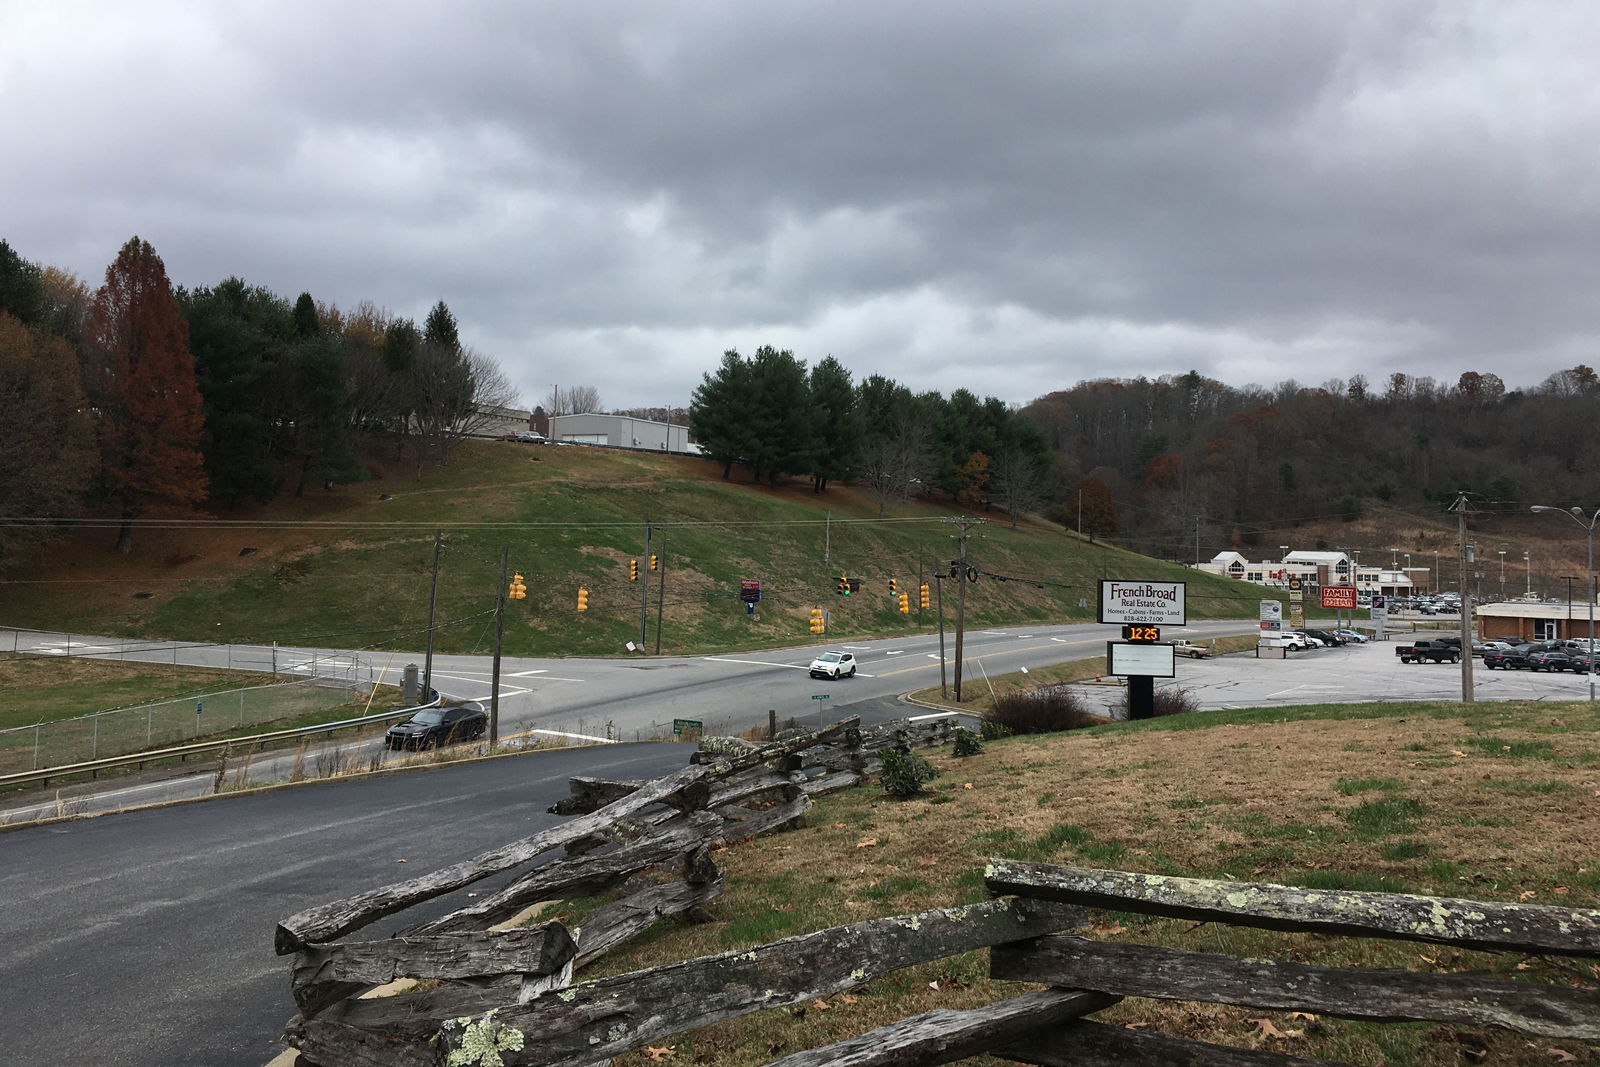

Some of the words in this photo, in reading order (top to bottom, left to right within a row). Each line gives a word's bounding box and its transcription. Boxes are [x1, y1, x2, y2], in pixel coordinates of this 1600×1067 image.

[1110, 583, 1144, 600] French
[1146, 584, 1177, 602] Broad
[1324, 588, 1354, 598] FAMILY
[1121, 598, 1135, 607] Real
[1136, 599, 1156, 608] Estate
[1156, 600, 1167, 608] Co.
[1324, 598, 1353, 607] DOLLAR
